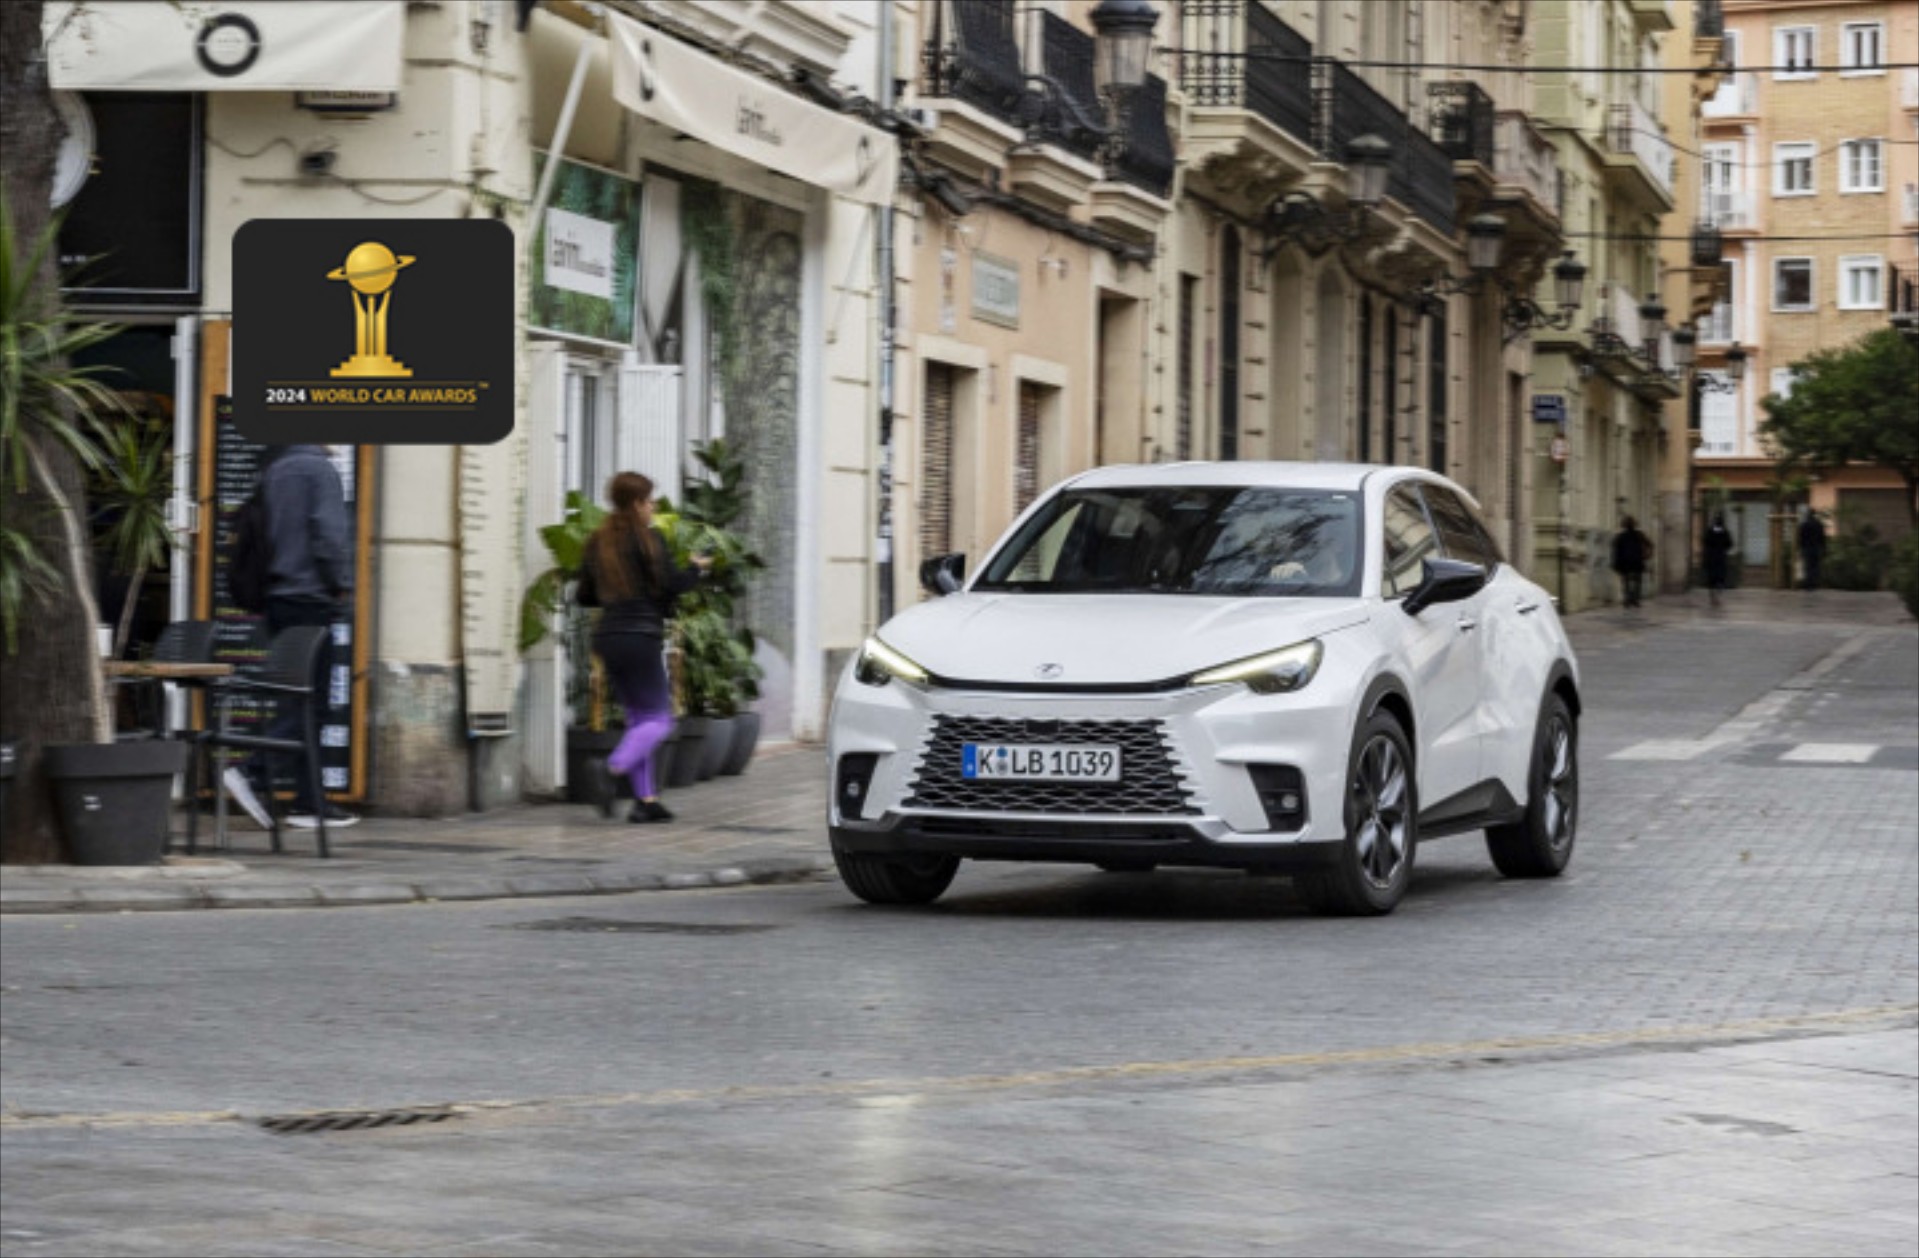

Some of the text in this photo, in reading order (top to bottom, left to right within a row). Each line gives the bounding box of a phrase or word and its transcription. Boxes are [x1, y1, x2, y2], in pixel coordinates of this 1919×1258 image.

[979, 749, 1114, 776] K LB 1039
